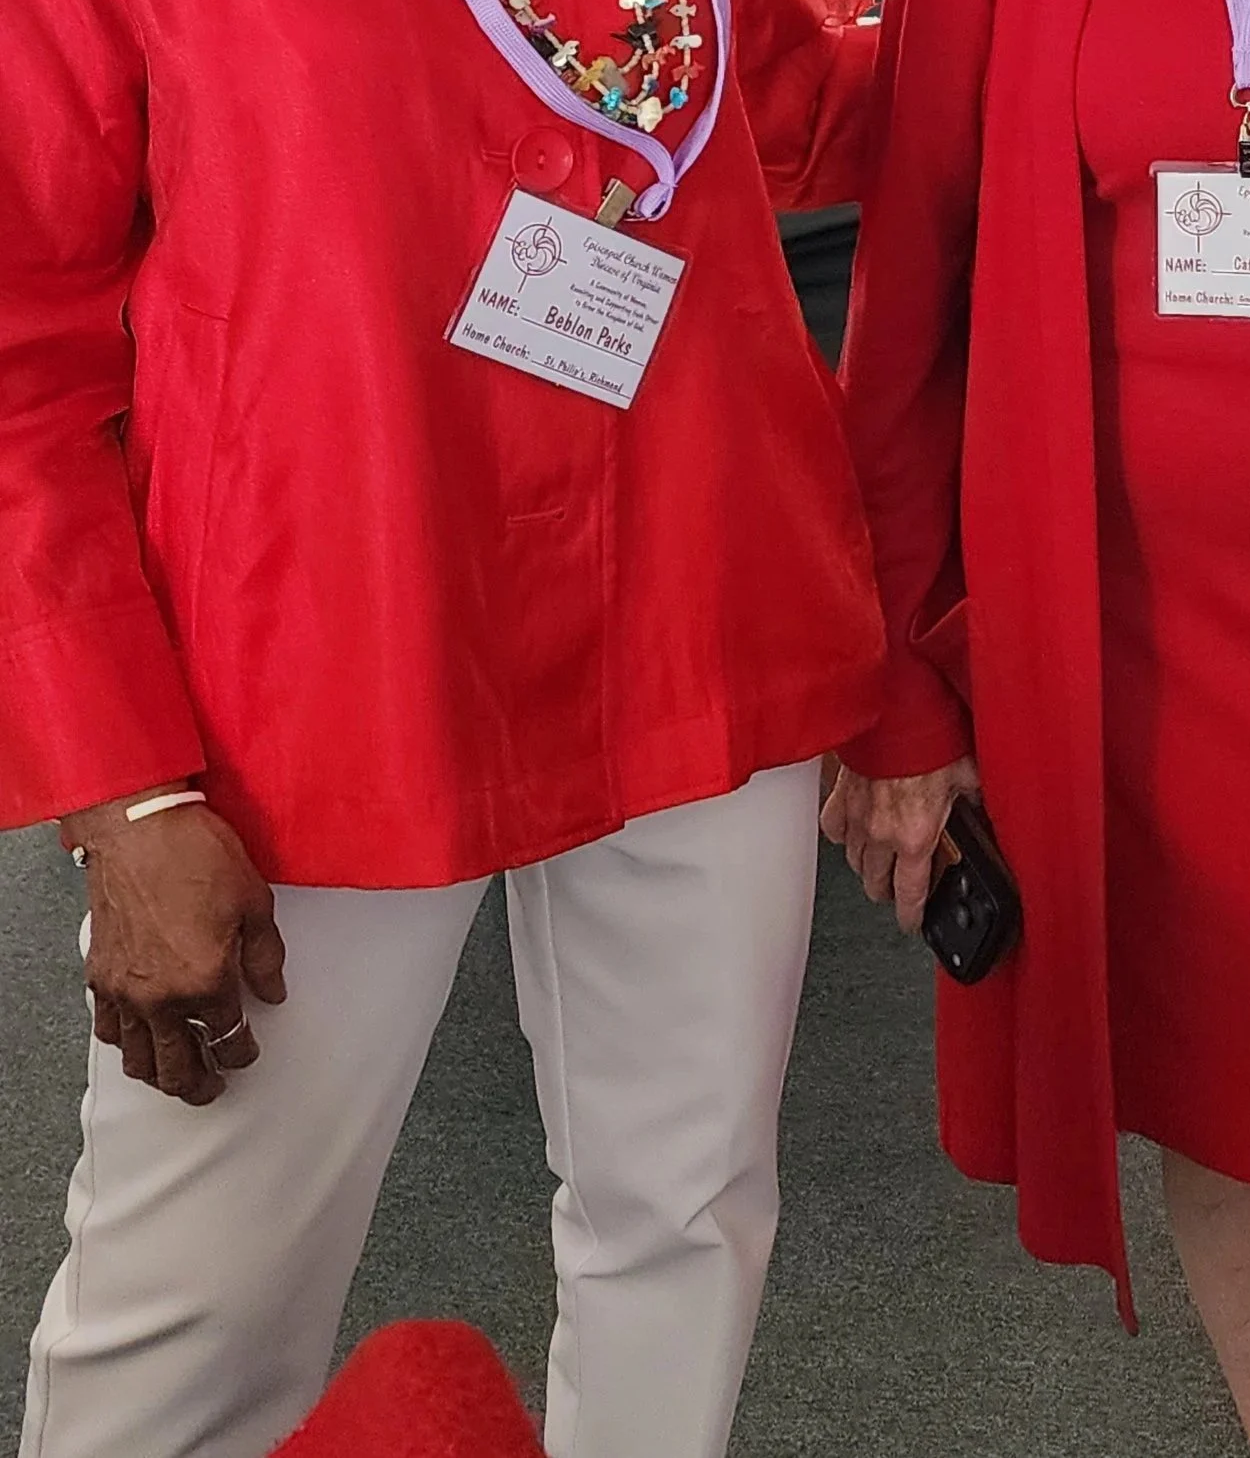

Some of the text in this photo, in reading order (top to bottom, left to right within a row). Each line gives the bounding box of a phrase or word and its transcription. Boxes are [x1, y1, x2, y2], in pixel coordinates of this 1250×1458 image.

[583, 235, 625, 262] Episcopal
[623, 253, 651, 274] Church
[1165, 257, 1207, 273] NAME:
[1165, 289, 1192, 303] Home
[1195, 290, 1233, 305] Church:
[477, 287, 633, 356] NAME: Beblon Parks
[462, 322, 491, 345] Home
[492, 334, 531, 360] Church:
[589, 371, 625, 393] Richmond
